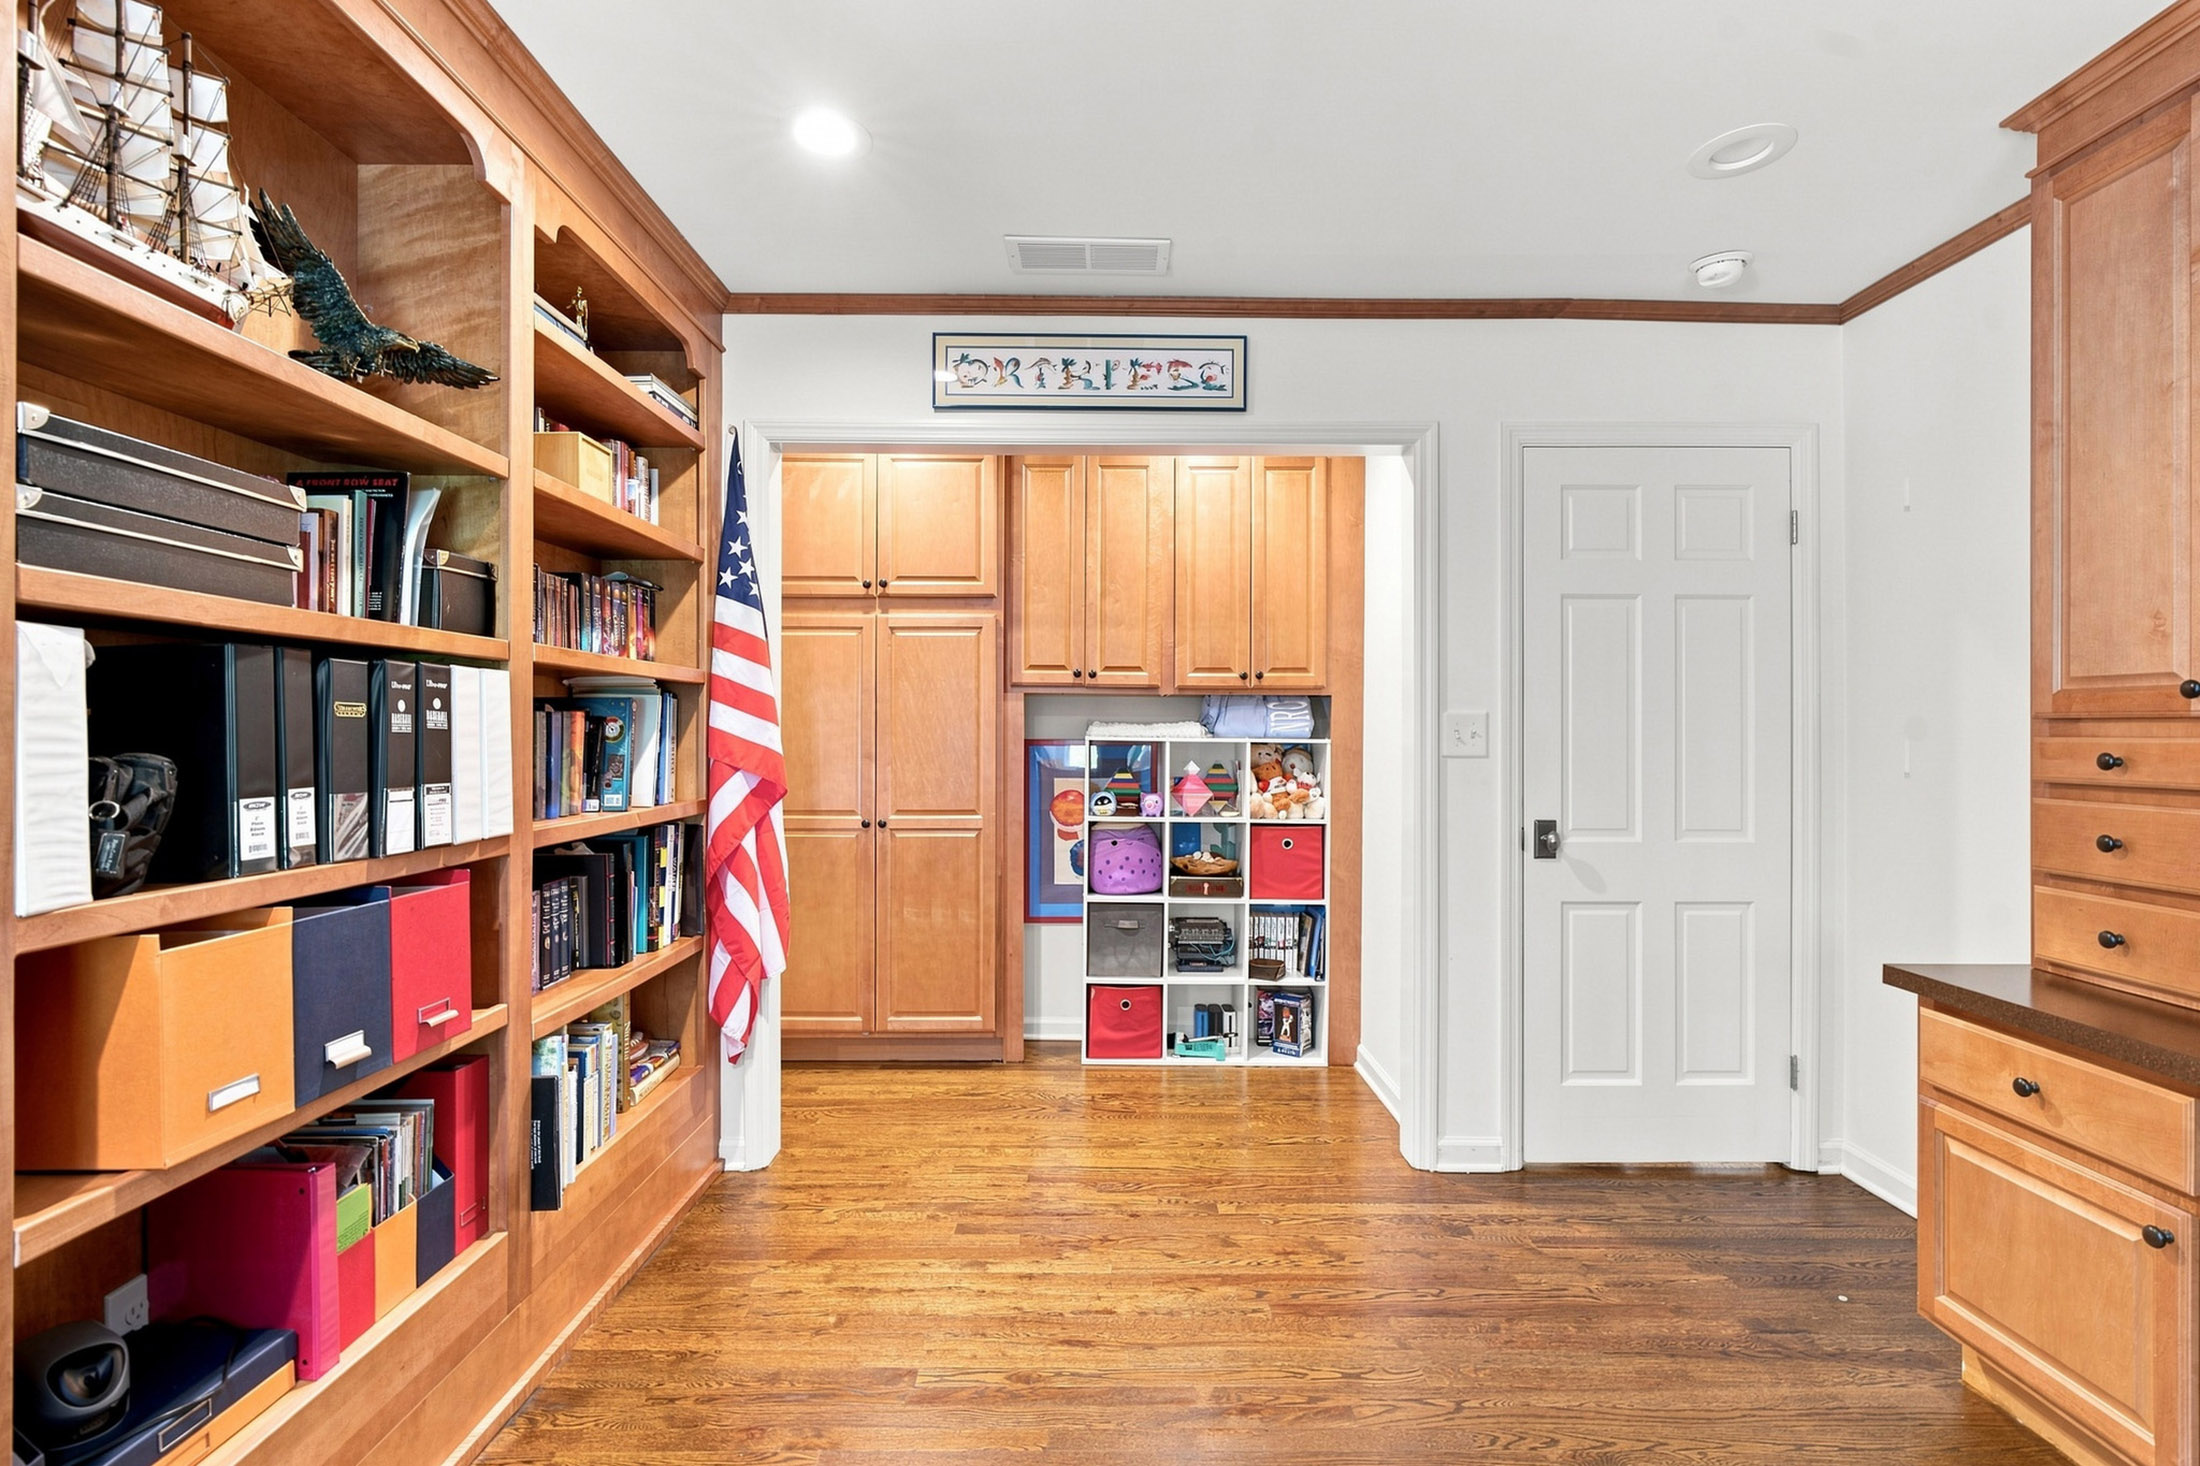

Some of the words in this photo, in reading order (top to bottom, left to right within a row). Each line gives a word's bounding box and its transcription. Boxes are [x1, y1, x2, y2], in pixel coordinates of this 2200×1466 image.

[305, 478, 340, 487] FRONT
[343, 478, 369, 487] ROW
[372, 478, 399, 487] SEAT
